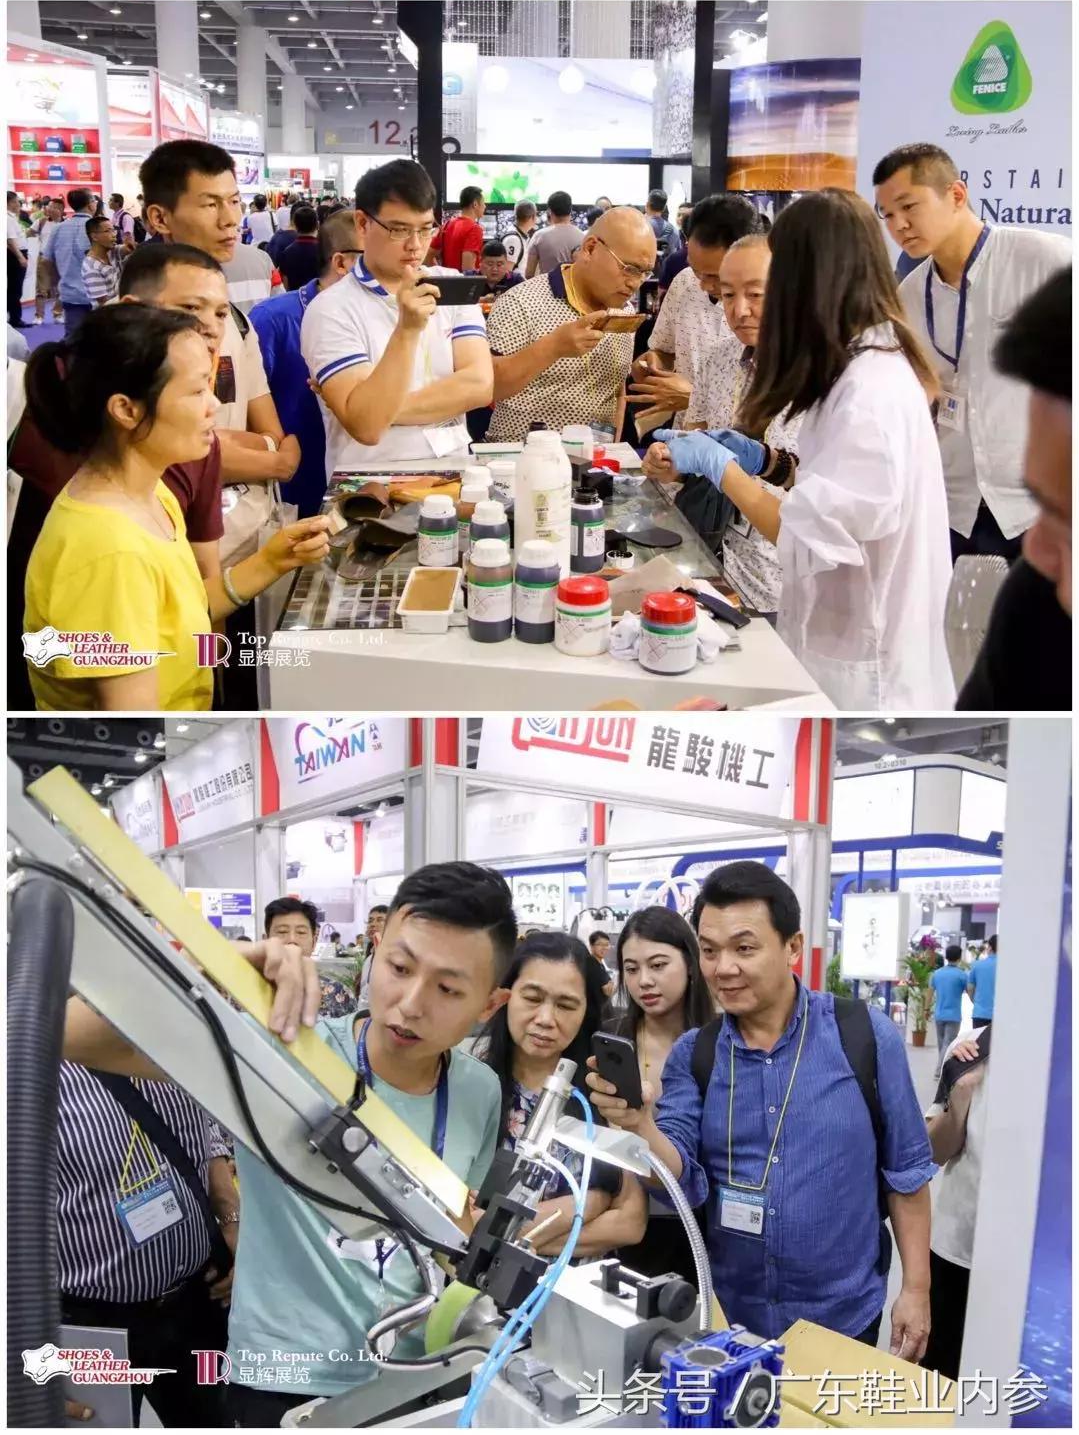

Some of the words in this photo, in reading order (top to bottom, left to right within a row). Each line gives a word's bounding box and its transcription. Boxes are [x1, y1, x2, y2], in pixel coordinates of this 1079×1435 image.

[972, 82, 1007, 95] FENICE
[508, 245, 515, 256] 3
[294, 729, 366, 777] TAIWAN
[646, 724, 775, 789] 龍駿機工
